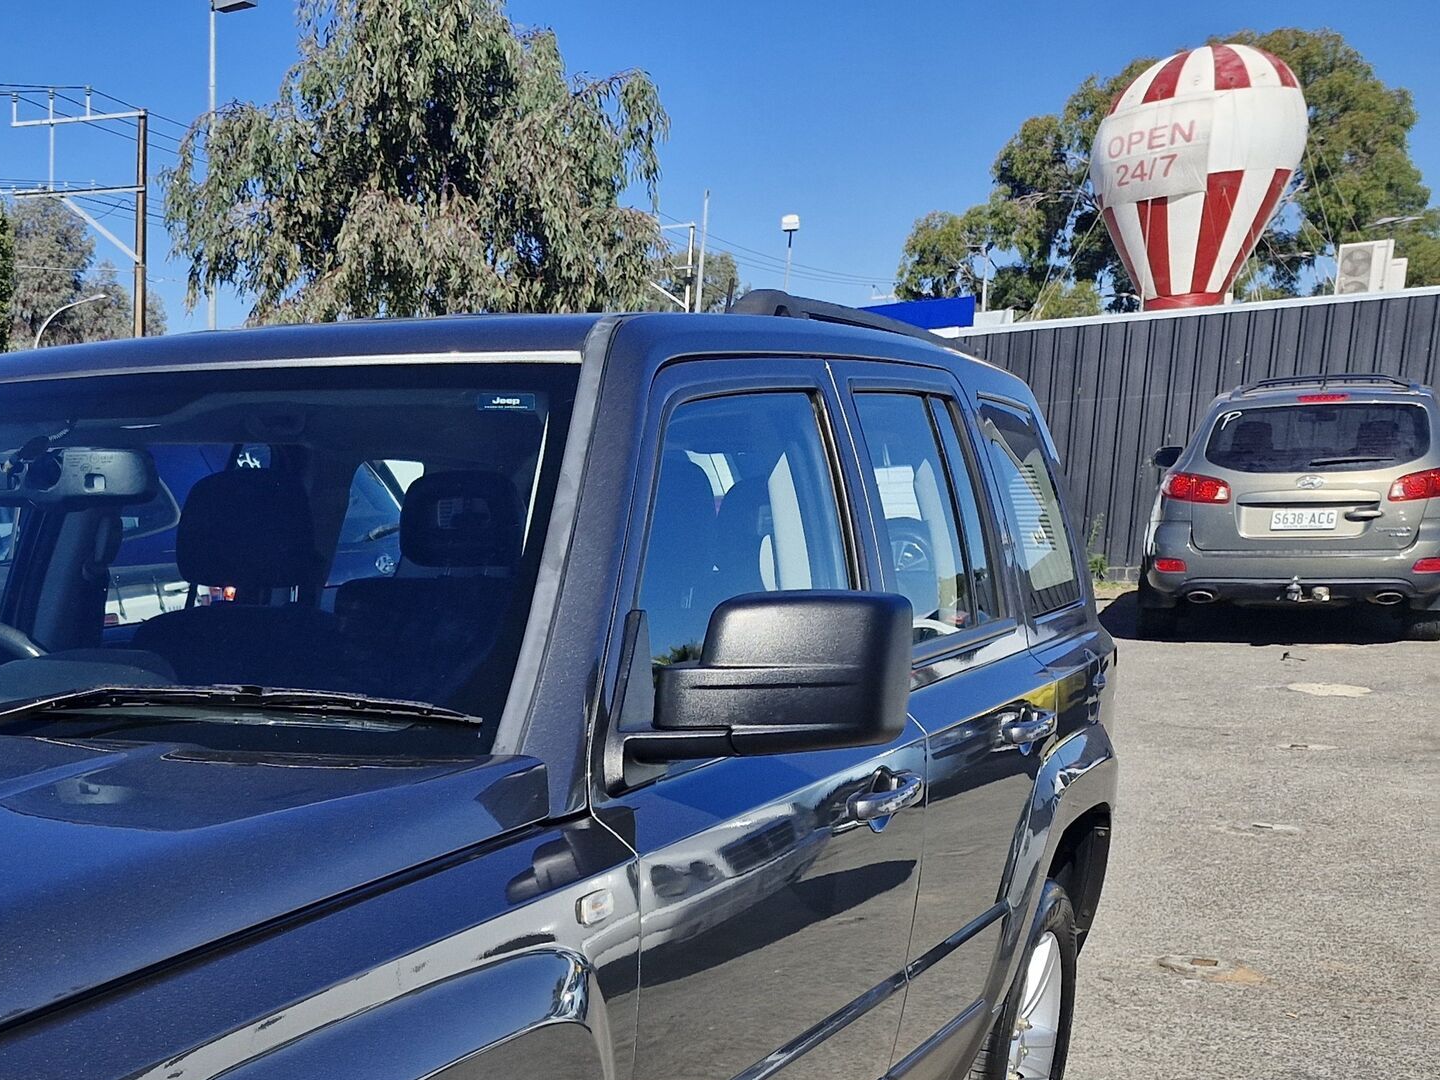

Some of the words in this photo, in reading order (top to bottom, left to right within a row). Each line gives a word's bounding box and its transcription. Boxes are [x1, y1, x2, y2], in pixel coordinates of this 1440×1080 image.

[1108, 120, 1195, 159] OPEN
[1116, 153, 1178, 187] 24/7
[491, 397, 520, 405] Jeep
[1221, 411, 1243, 430] P
